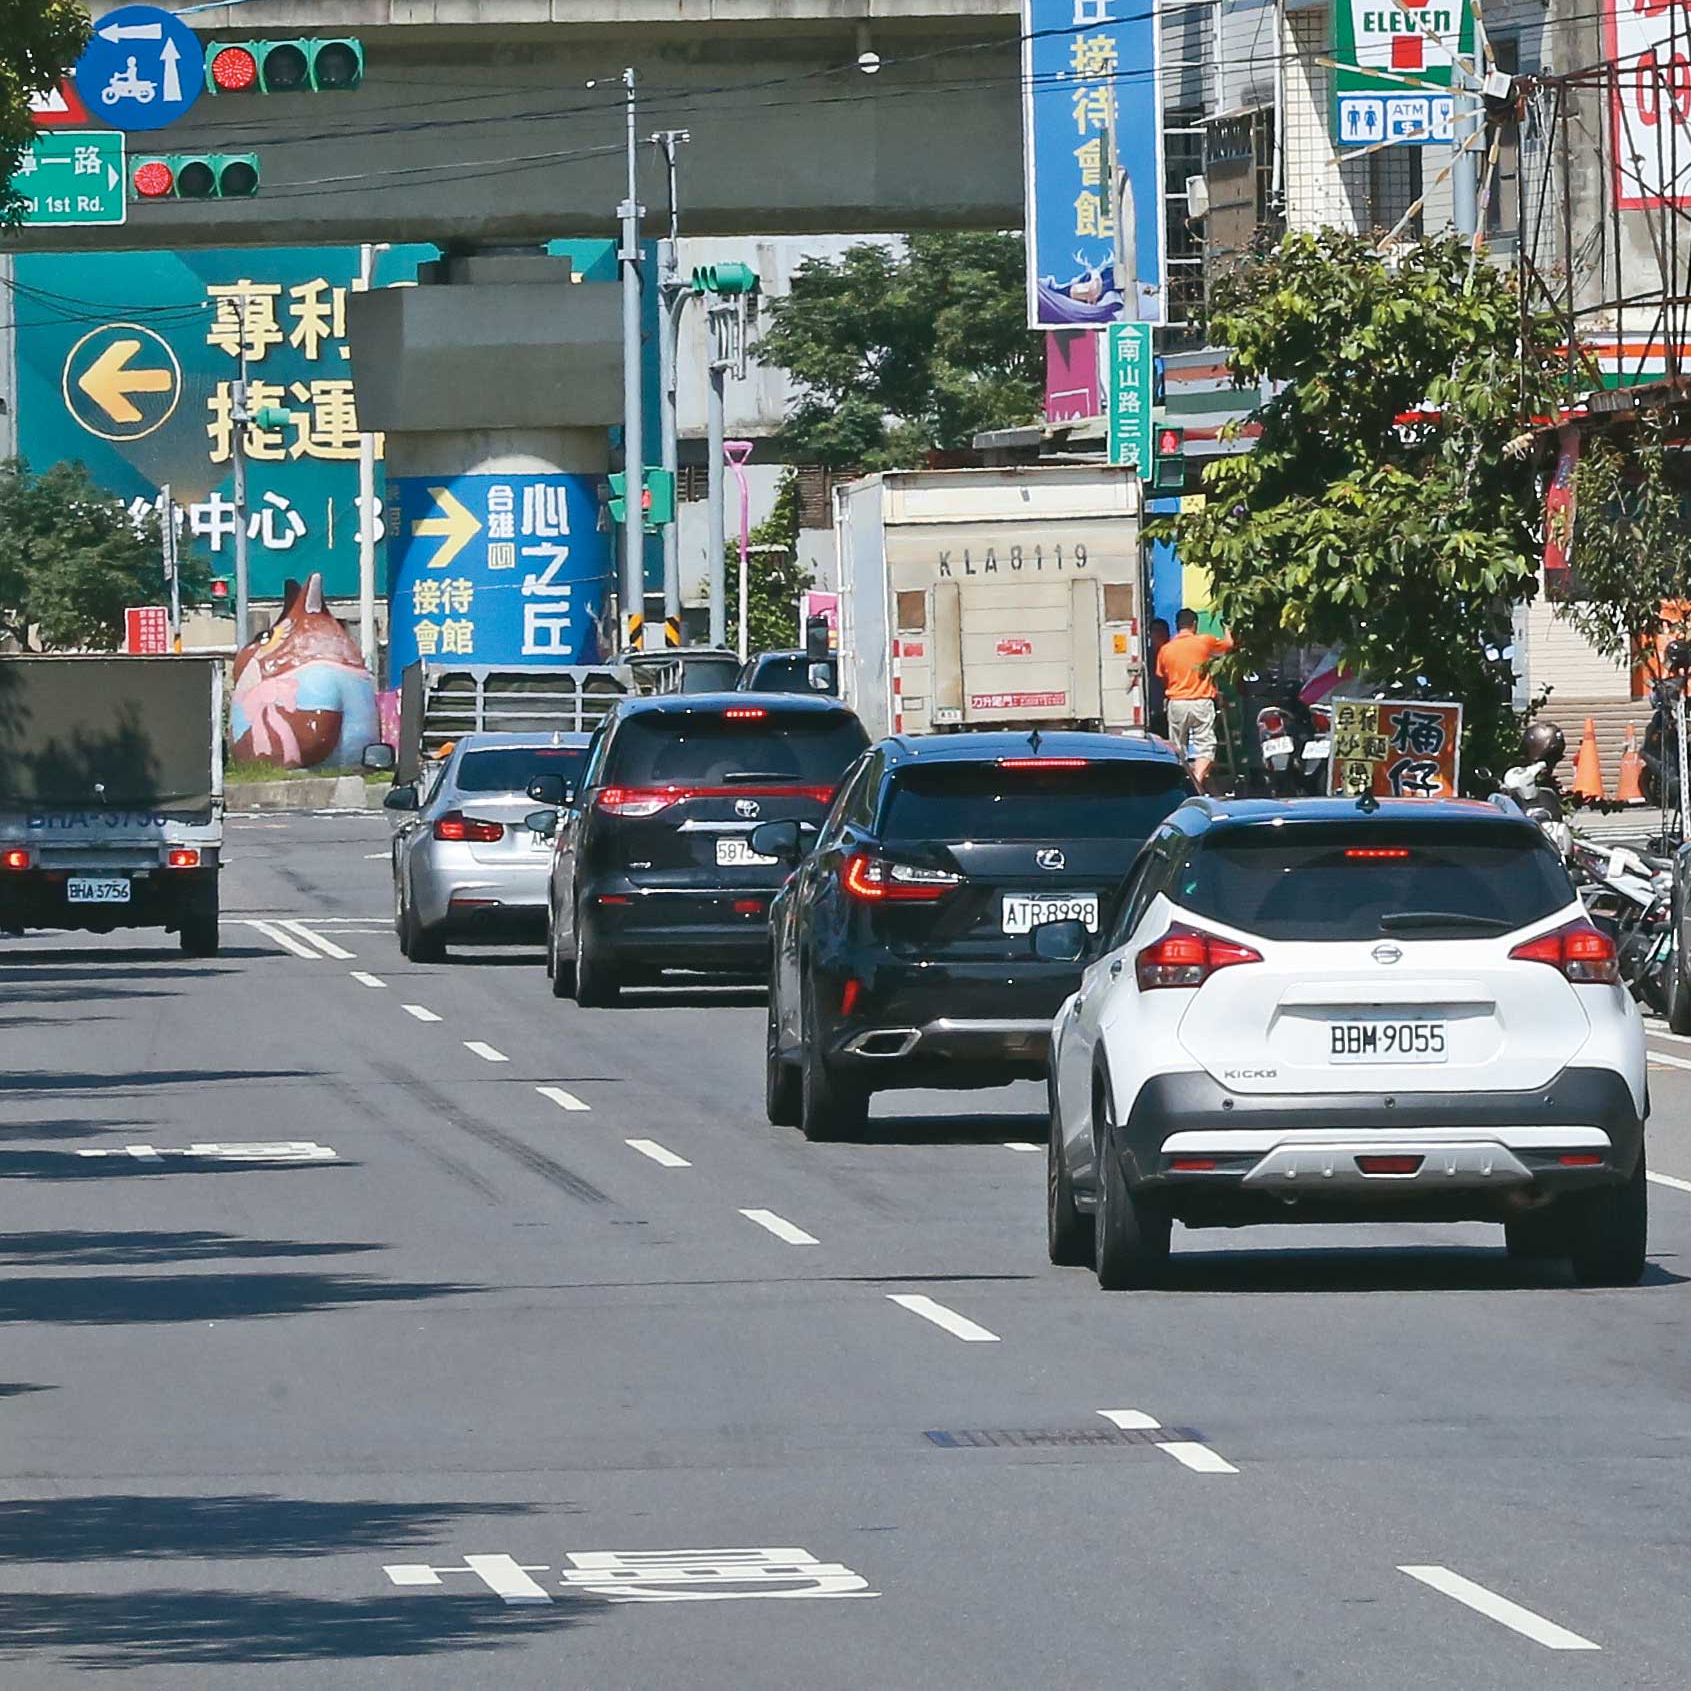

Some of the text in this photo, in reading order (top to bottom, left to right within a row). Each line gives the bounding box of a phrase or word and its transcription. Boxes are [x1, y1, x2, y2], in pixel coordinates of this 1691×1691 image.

[1393, 104, 1424, 115] ATM
[45, 196, 70, 213] 1st
[77, 196, 105, 213] Rd.
[206, 380, 385, 463] 捷運
[1117, 339, 1142, 471] 南山路三段
[521, 483, 573, 655] 心之丘
[413, 577, 474, 615] 接待
[413, 619, 474, 656] 會館
